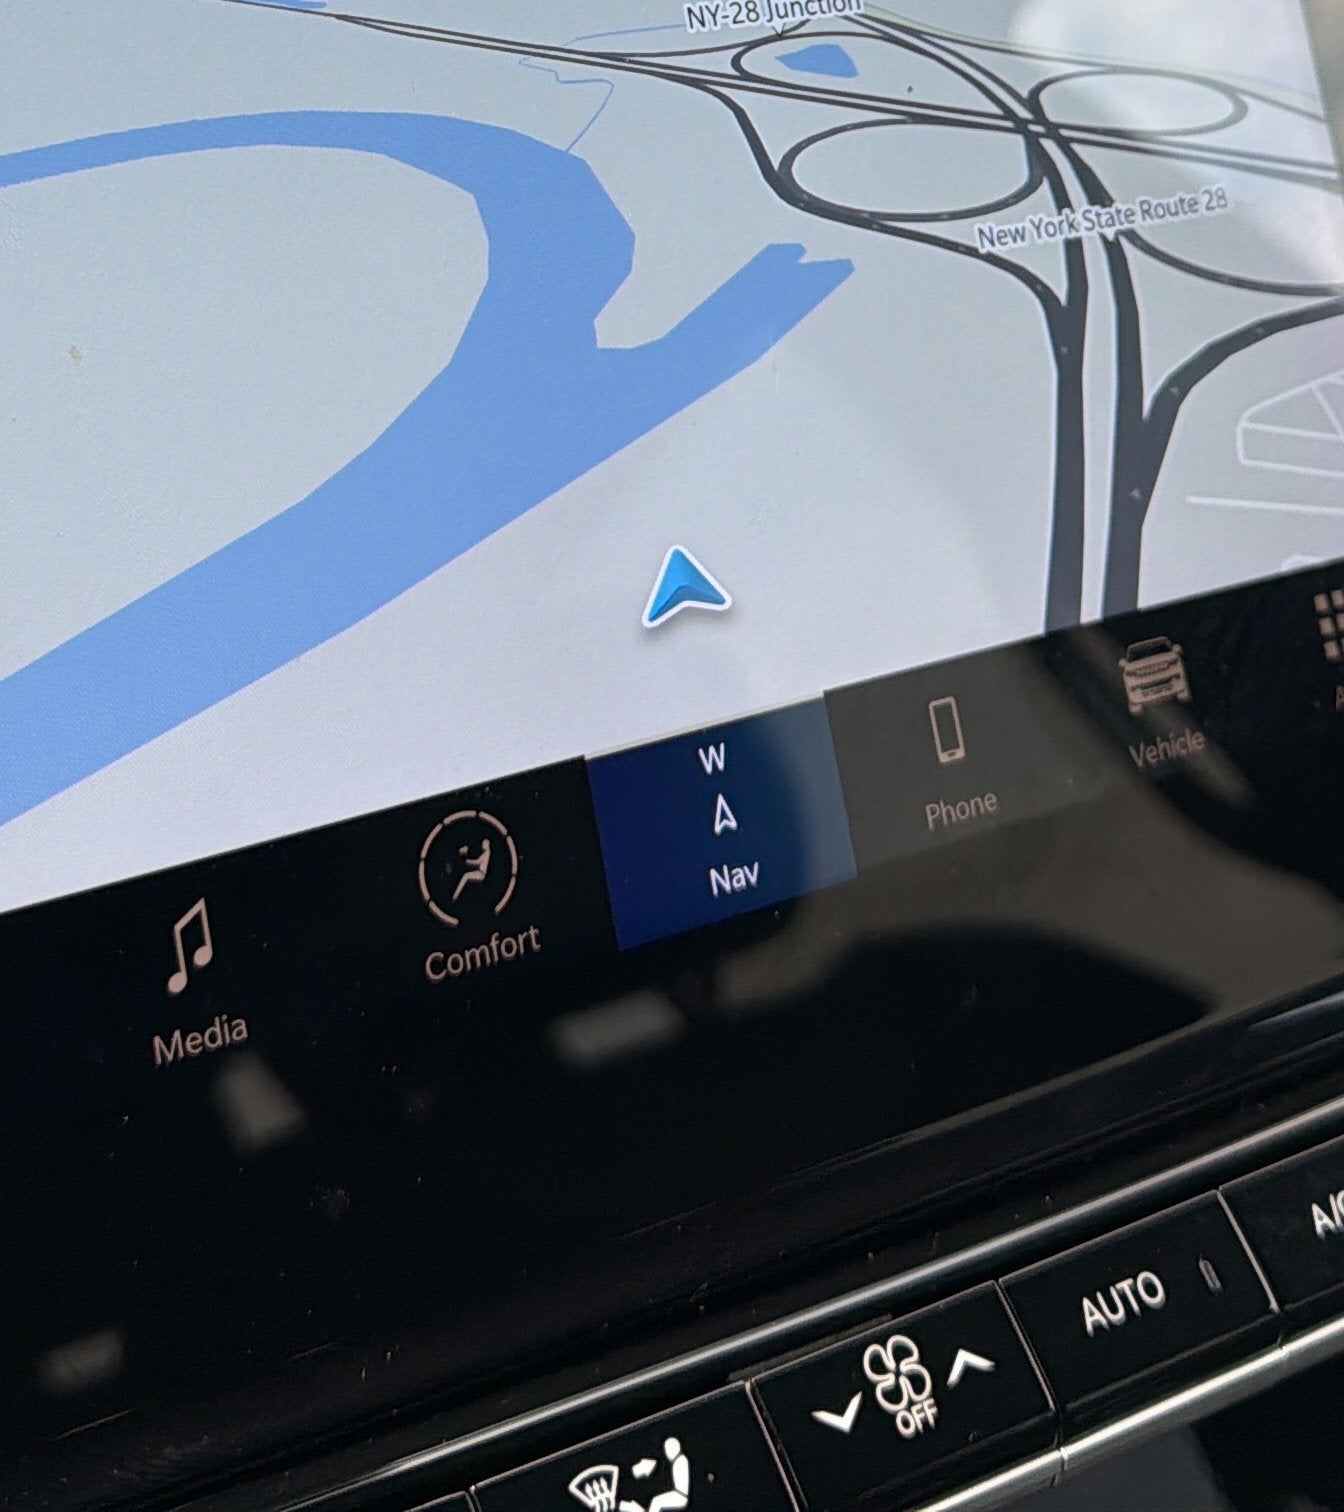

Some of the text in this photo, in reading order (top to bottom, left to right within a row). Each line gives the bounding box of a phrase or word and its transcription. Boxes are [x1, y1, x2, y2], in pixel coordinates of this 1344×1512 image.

[687, 1, 759, 30] NY-28
[978, 189, 1228, 251] New York State Route 28
[698, 745, 727, 774] W
[1130, 729, 1206, 767] Vehicle
[925, 790, 998, 830] Phone
[709, 861, 760, 896] Nav
[425, 924, 541, 981] Comfort
[153, 1014, 249, 1065] Media
[1081, 1270, 1166, 1335] AUTO
[895, 1399, 939, 1438] OFF
